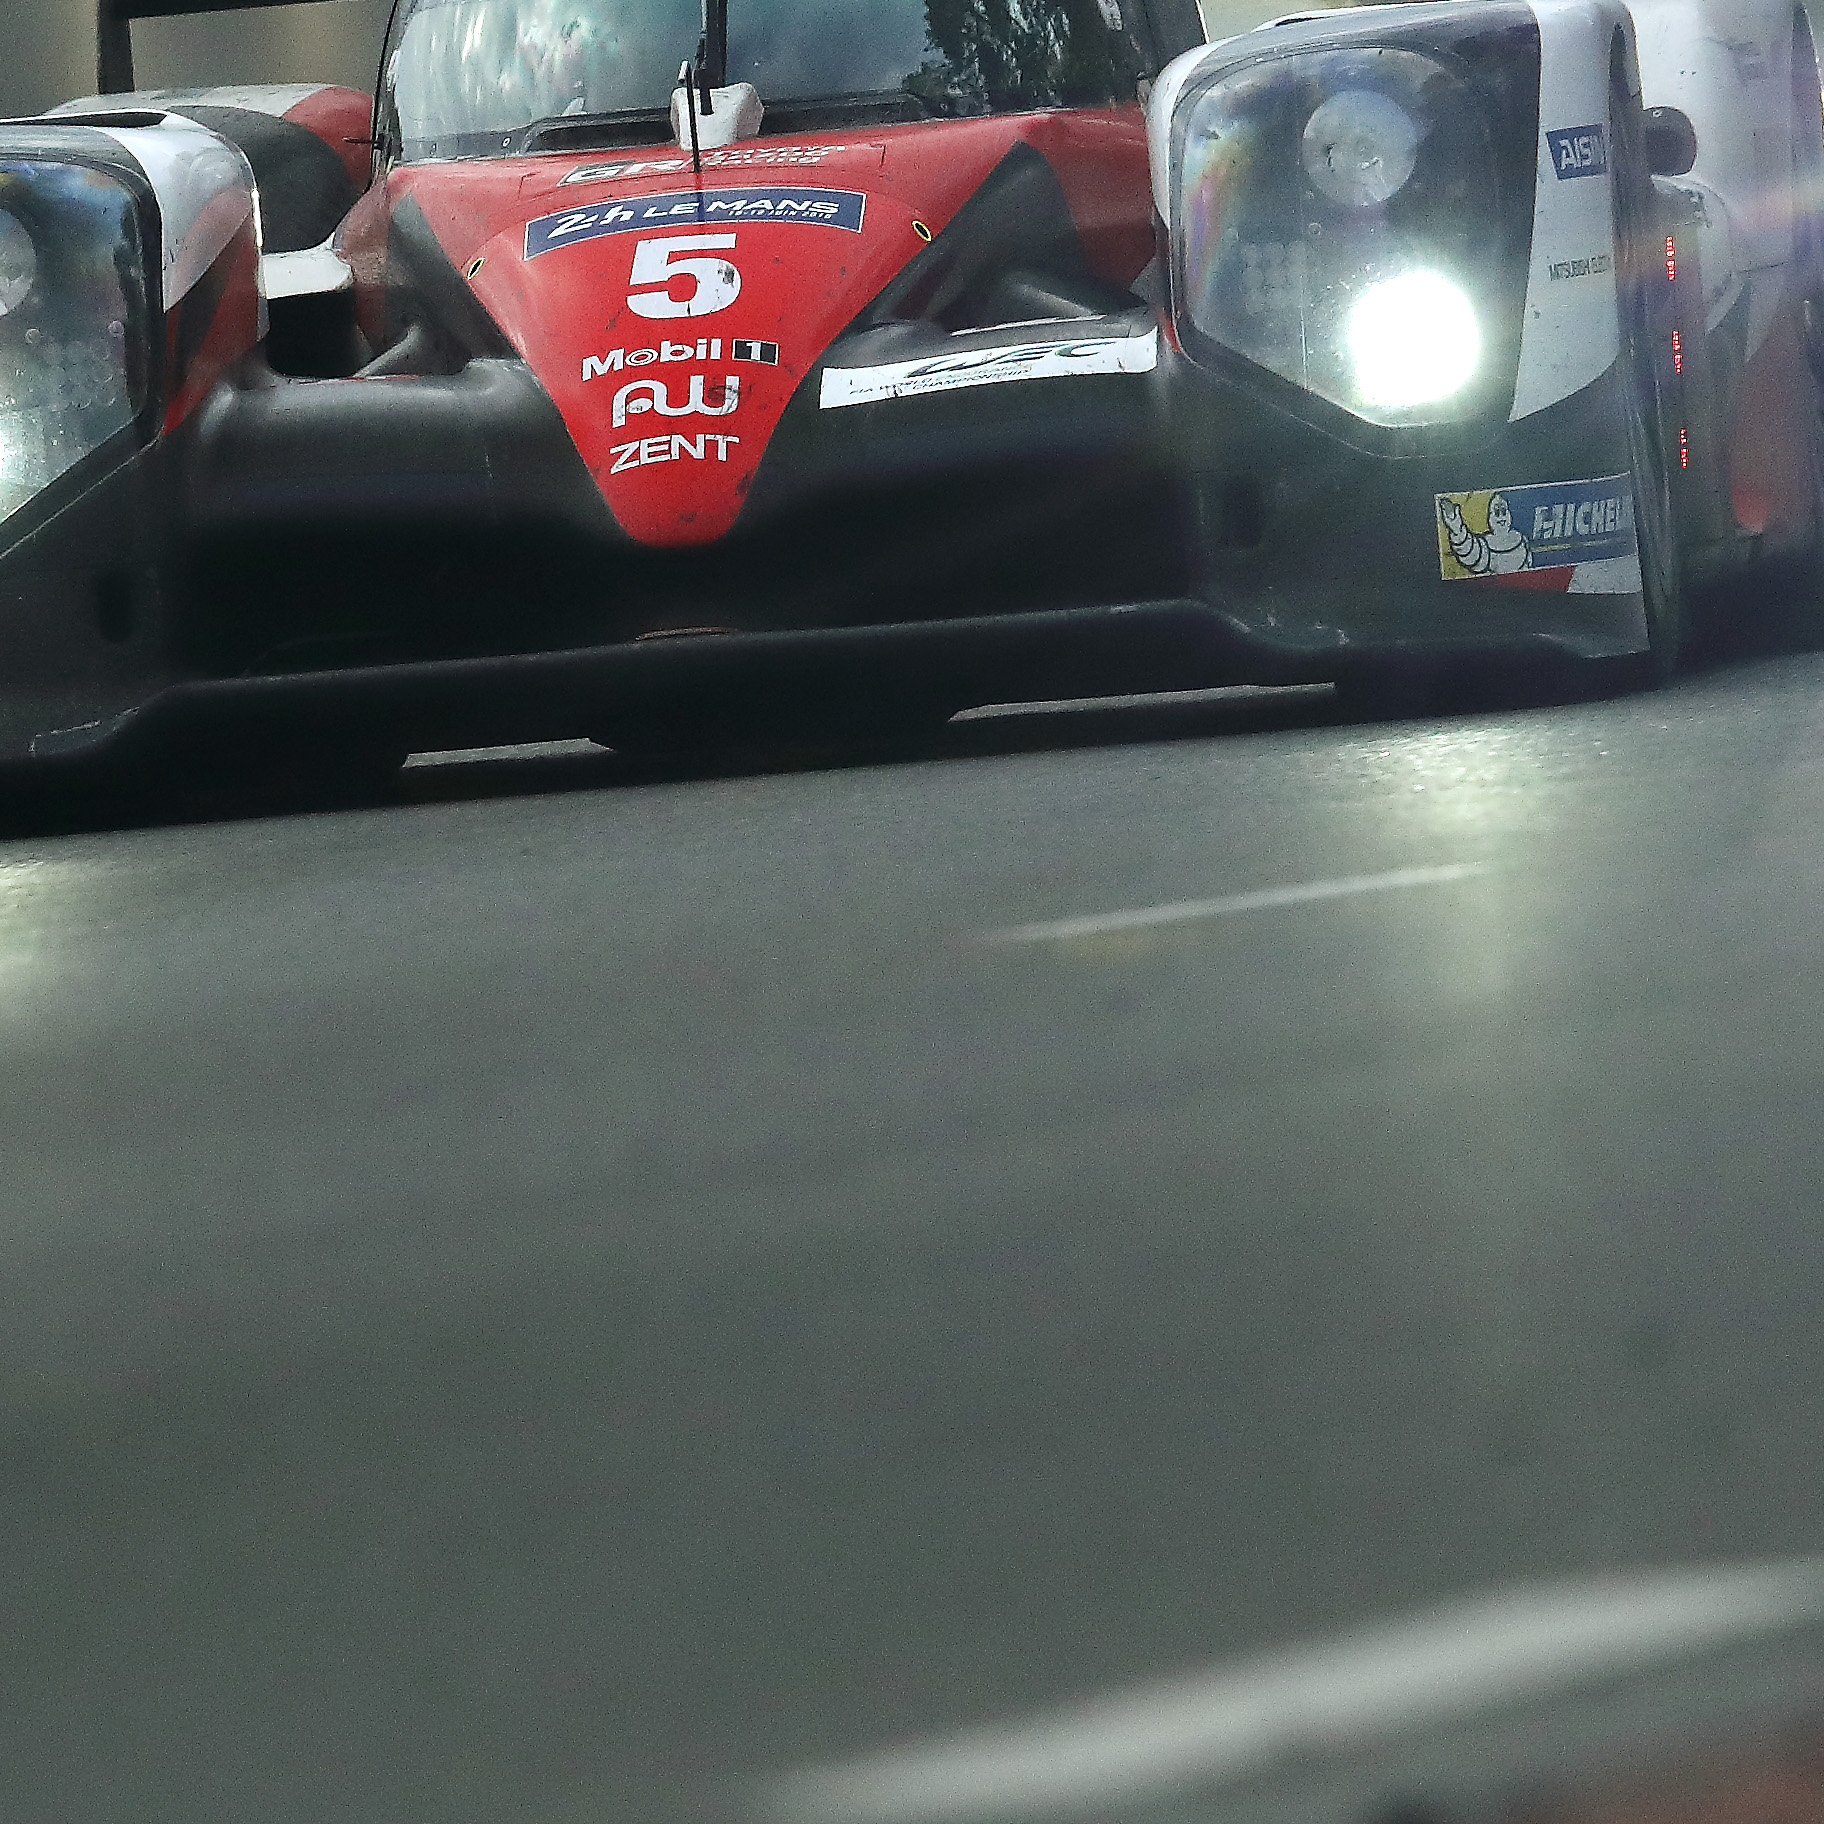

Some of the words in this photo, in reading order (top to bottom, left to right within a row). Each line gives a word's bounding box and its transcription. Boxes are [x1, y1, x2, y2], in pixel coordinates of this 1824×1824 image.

[642, 202, 700, 218] LE
[706, 198, 841, 215] MANS
[625, 232, 741, 319] 5
[582, 337, 722, 381] Mobil
[608, 433, 740, 475] ZENT
